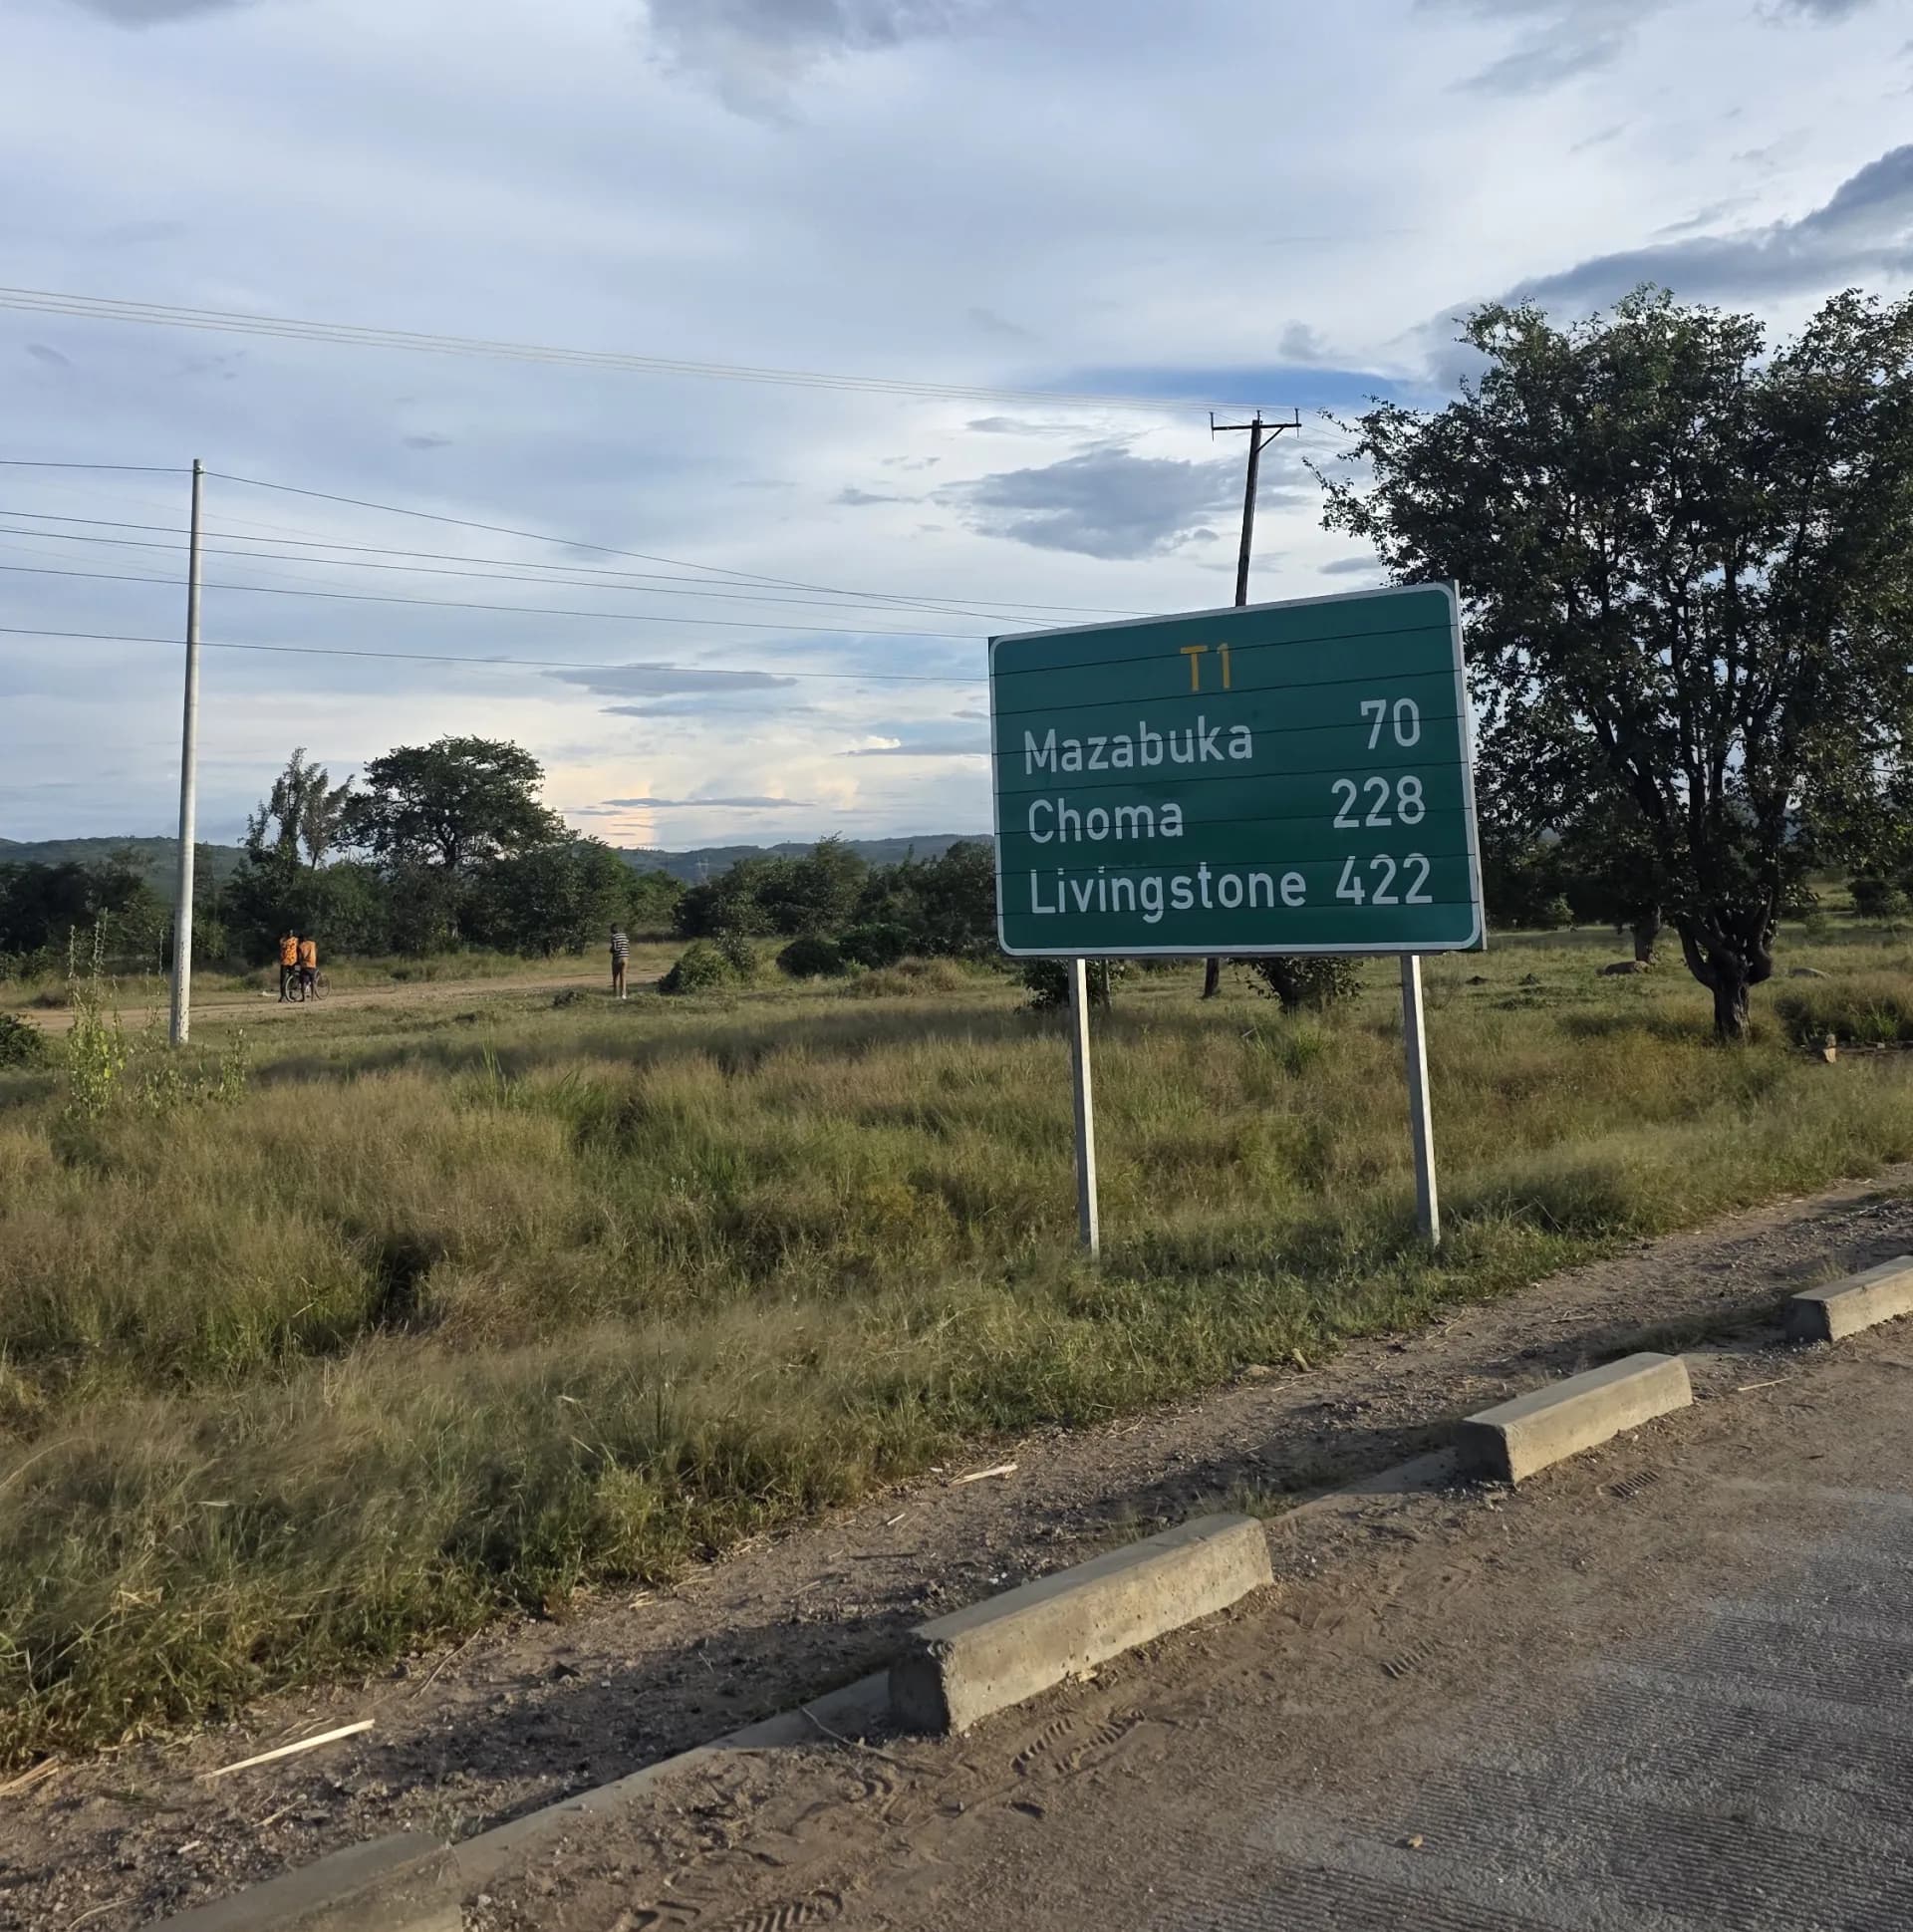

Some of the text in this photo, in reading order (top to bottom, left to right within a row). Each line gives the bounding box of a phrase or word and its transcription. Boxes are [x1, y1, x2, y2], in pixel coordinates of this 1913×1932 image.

[1181, 643, 1233, 692] T1
[1024, 697, 1421, 775] Mazabuka 70
[1027, 775, 1427, 844] Choma 228
[1029, 852, 1434, 924] Livingstone 422
